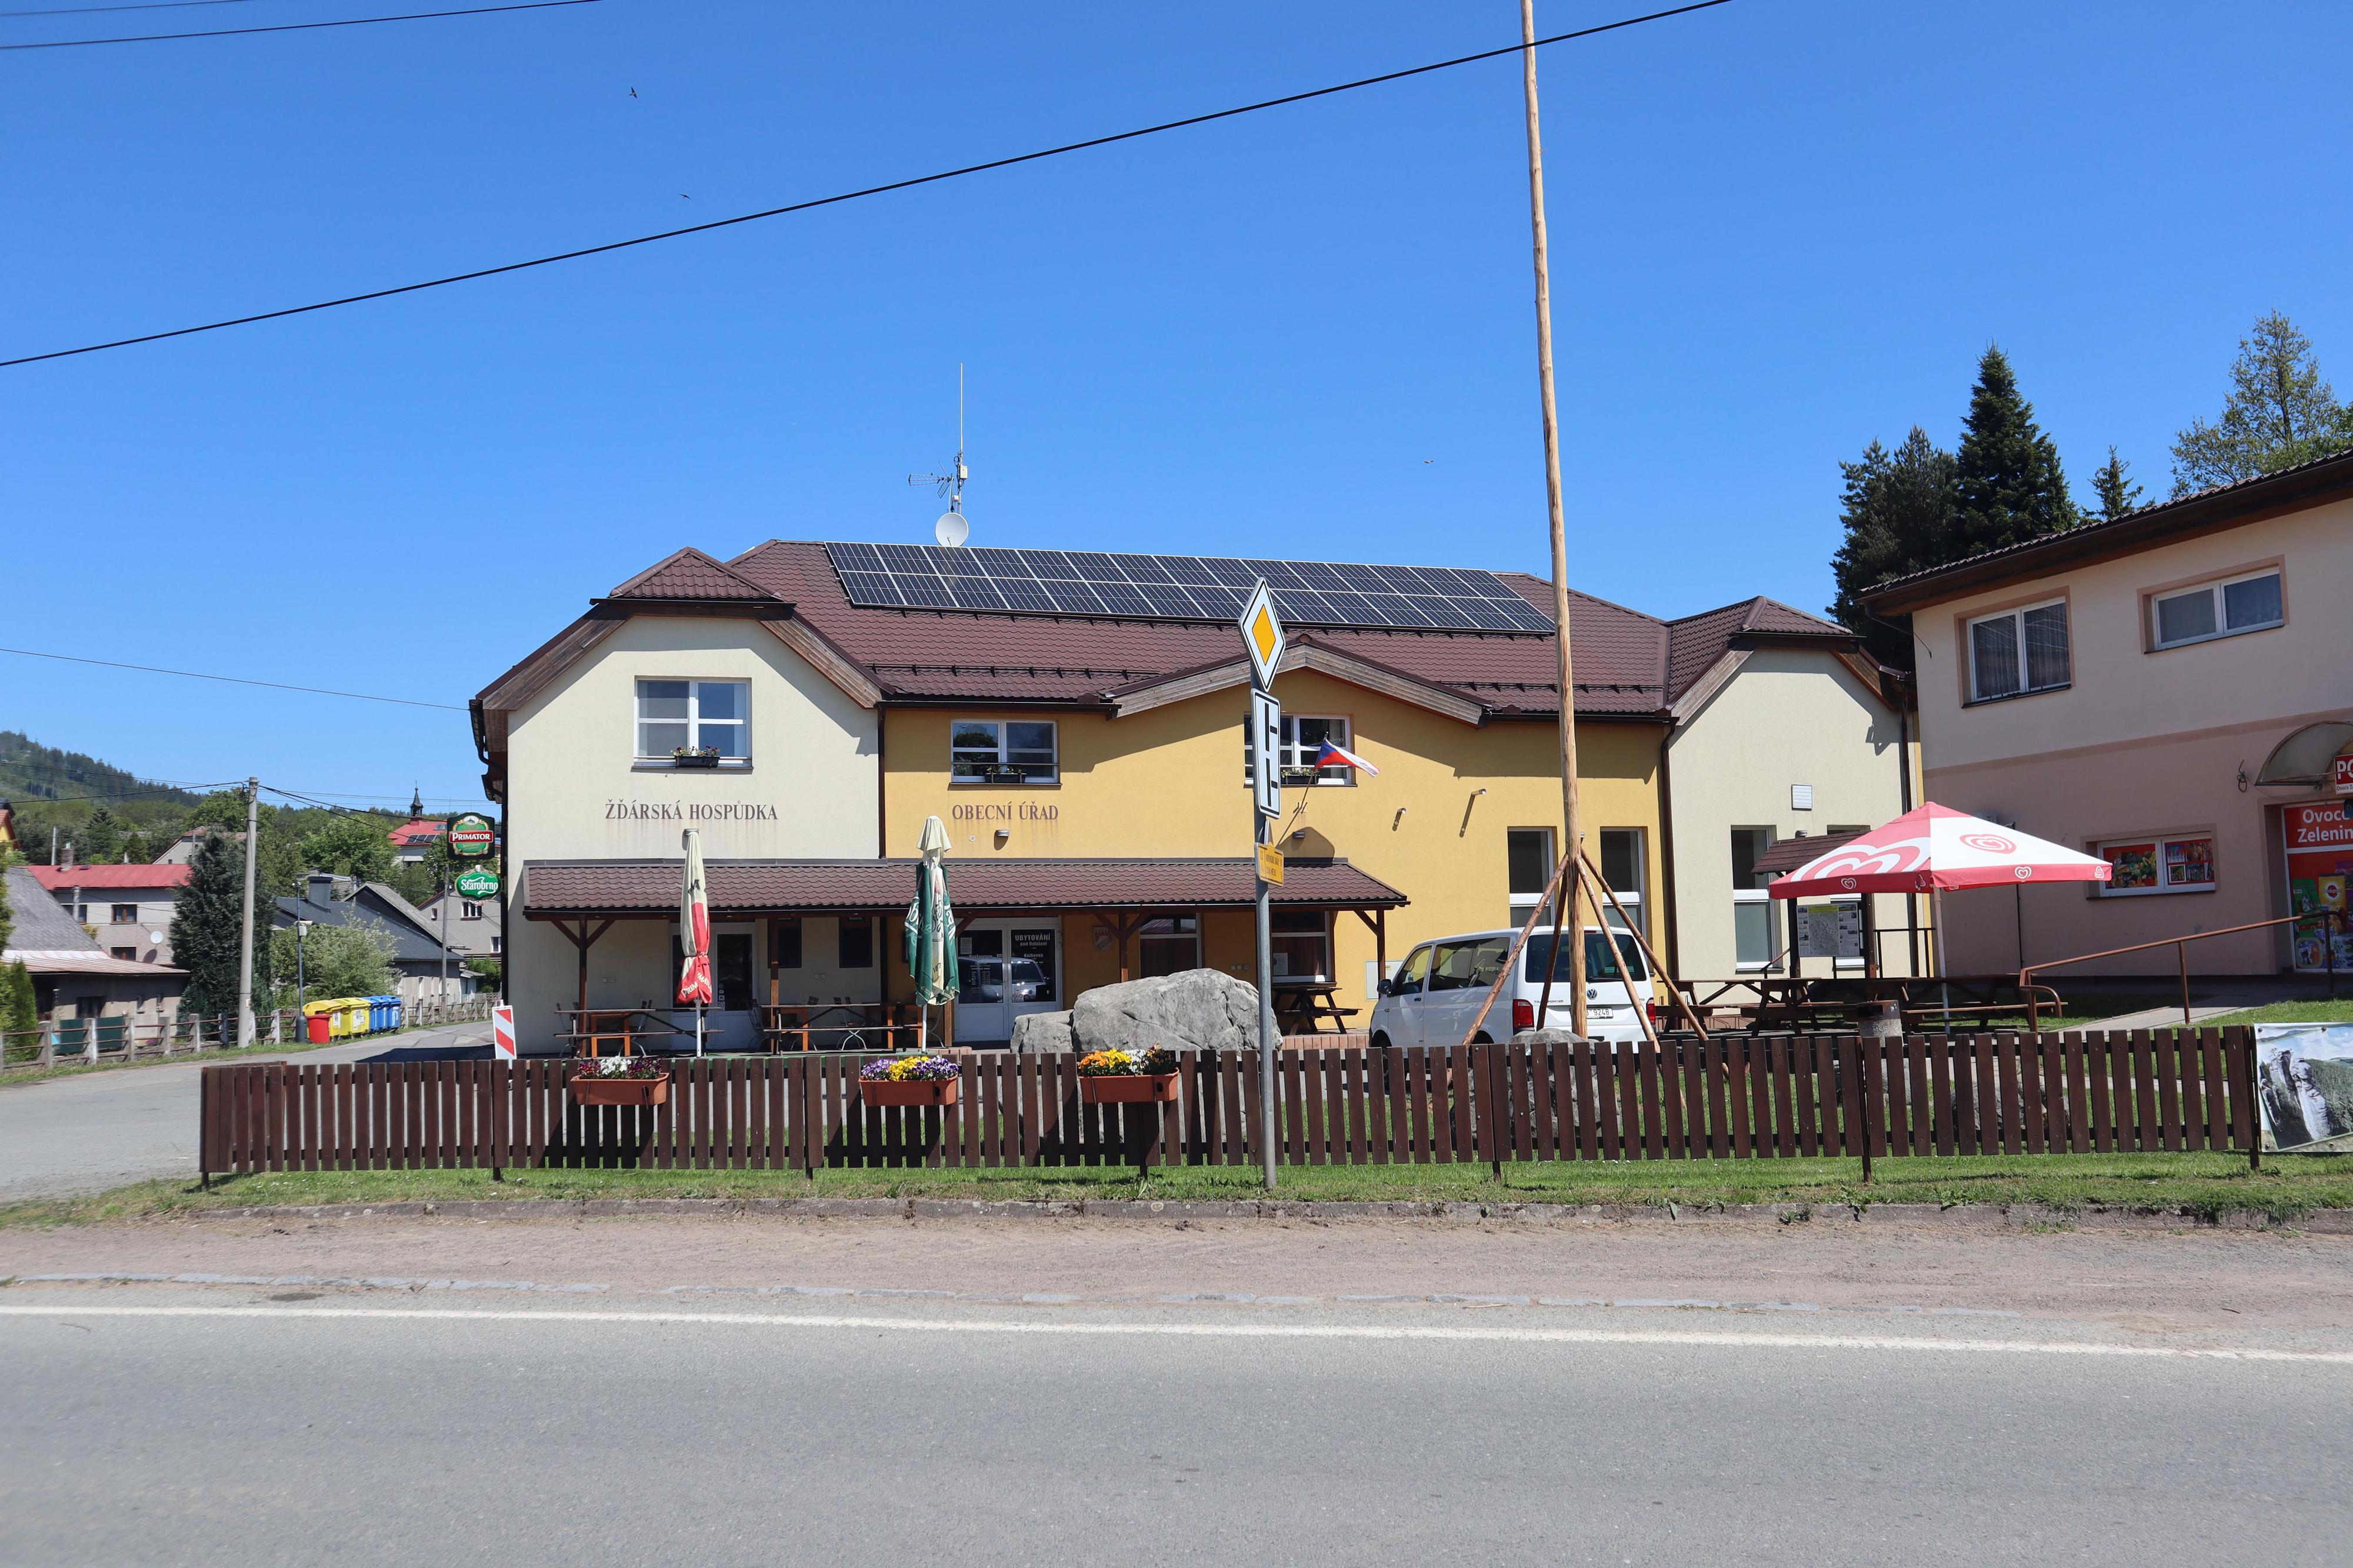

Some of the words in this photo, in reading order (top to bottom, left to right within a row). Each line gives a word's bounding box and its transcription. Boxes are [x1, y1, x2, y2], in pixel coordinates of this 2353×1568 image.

[605, 798, 684, 820] ŽĎÁRSKÁ
[689, 800, 778, 820] HOSPŮDKA
[952, 800, 1012, 820] OBECNÍ
[1018, 800, 1059, 820] ÚŘAD
[452, 832, 491, 842] PRIMATOR
[461, 877, 498, 893] Starobrno
[1015, 933, 1051, 941] UBYTOVÁNÍ
[1593, 1008, 1609, 1016] 9248
